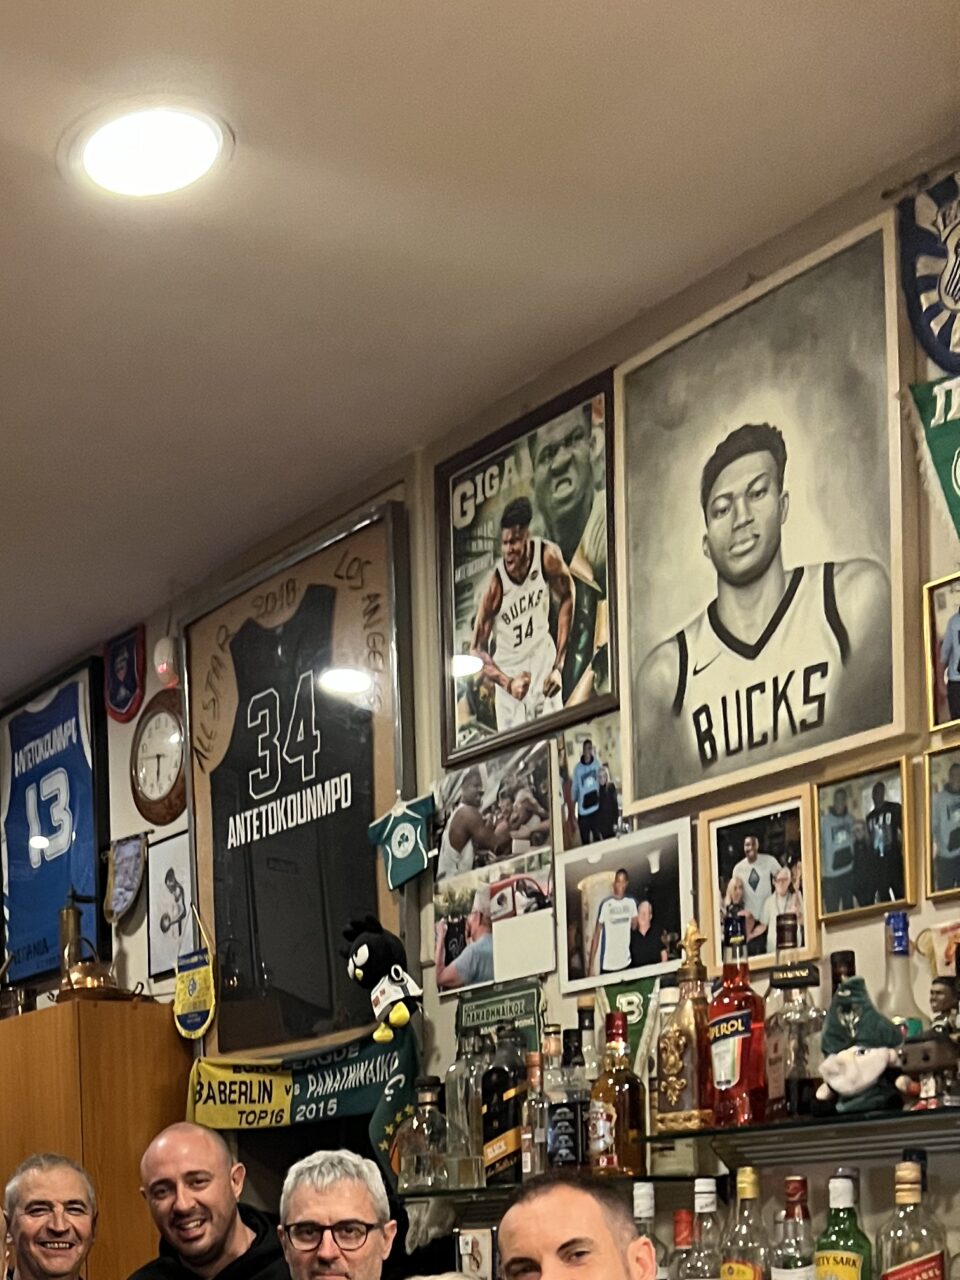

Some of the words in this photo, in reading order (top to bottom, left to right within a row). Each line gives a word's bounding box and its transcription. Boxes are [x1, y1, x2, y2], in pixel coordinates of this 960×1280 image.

[334, 551, 371, 590] LOS
[361, 592, 386, 713] ANGELS
[501, 589, 544, 625] BUCKS
[512, 615, 535, 648] 34
[248, 670, 321, 799] 34
[692, 661, 829, 772] BUCKS
[25, 766, 73, 869] 13
[227, 773, 352, 849] ANTETOKOUNMPO
[295, 1098, 337, 1122] 2015
[832, 1255, 858, 1268] SARK
